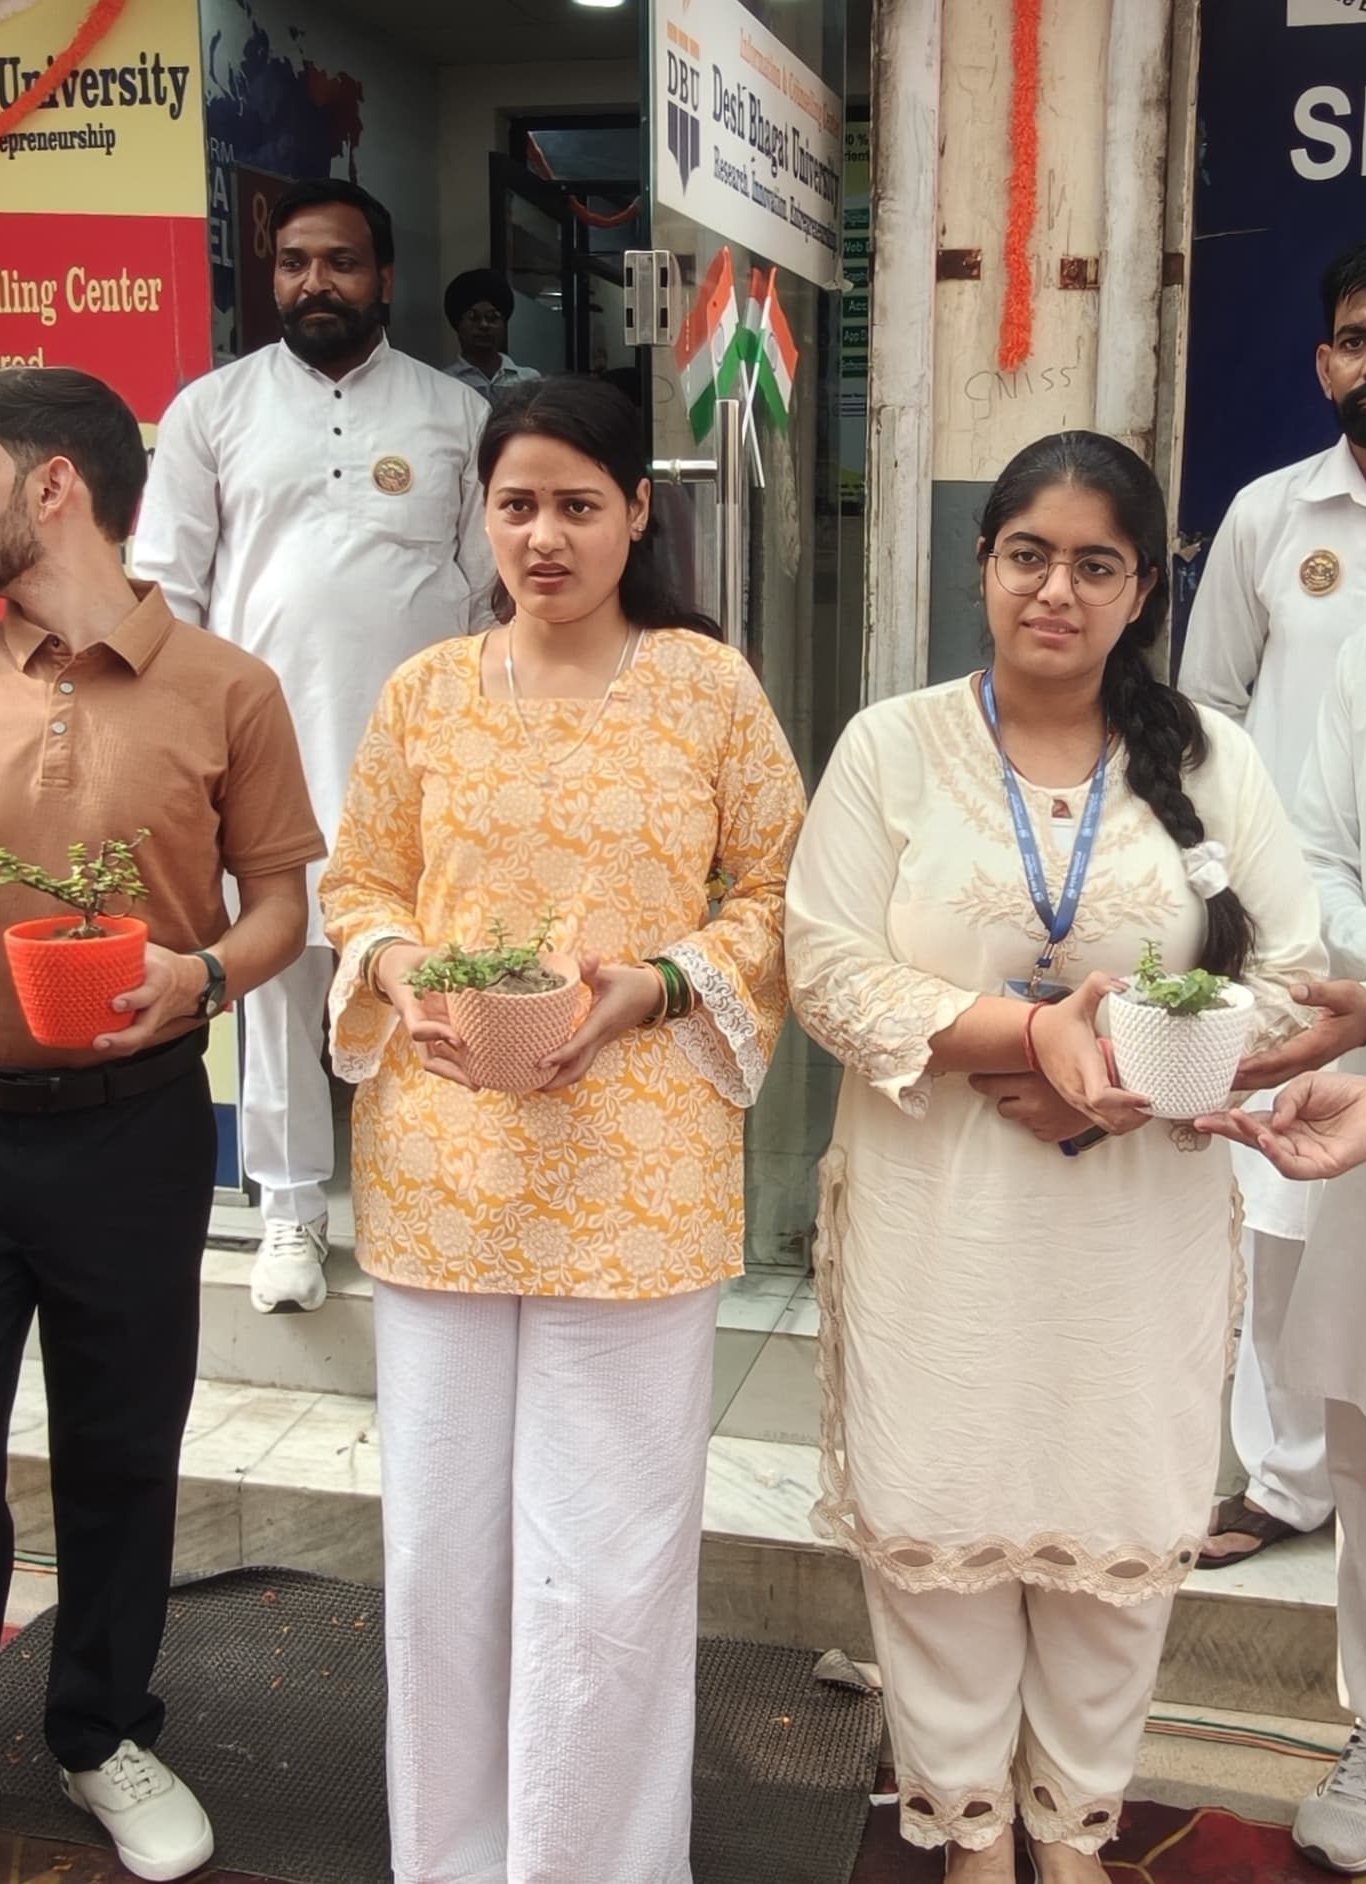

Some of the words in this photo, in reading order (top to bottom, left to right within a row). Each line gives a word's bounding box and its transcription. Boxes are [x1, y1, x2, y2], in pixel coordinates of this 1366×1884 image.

[667, 49, 700, 112] DBU
[712, 64, 747, 140] Desh
[747, 92, 789, 179] Bhagat
[65, 266, 162, 314] Center
